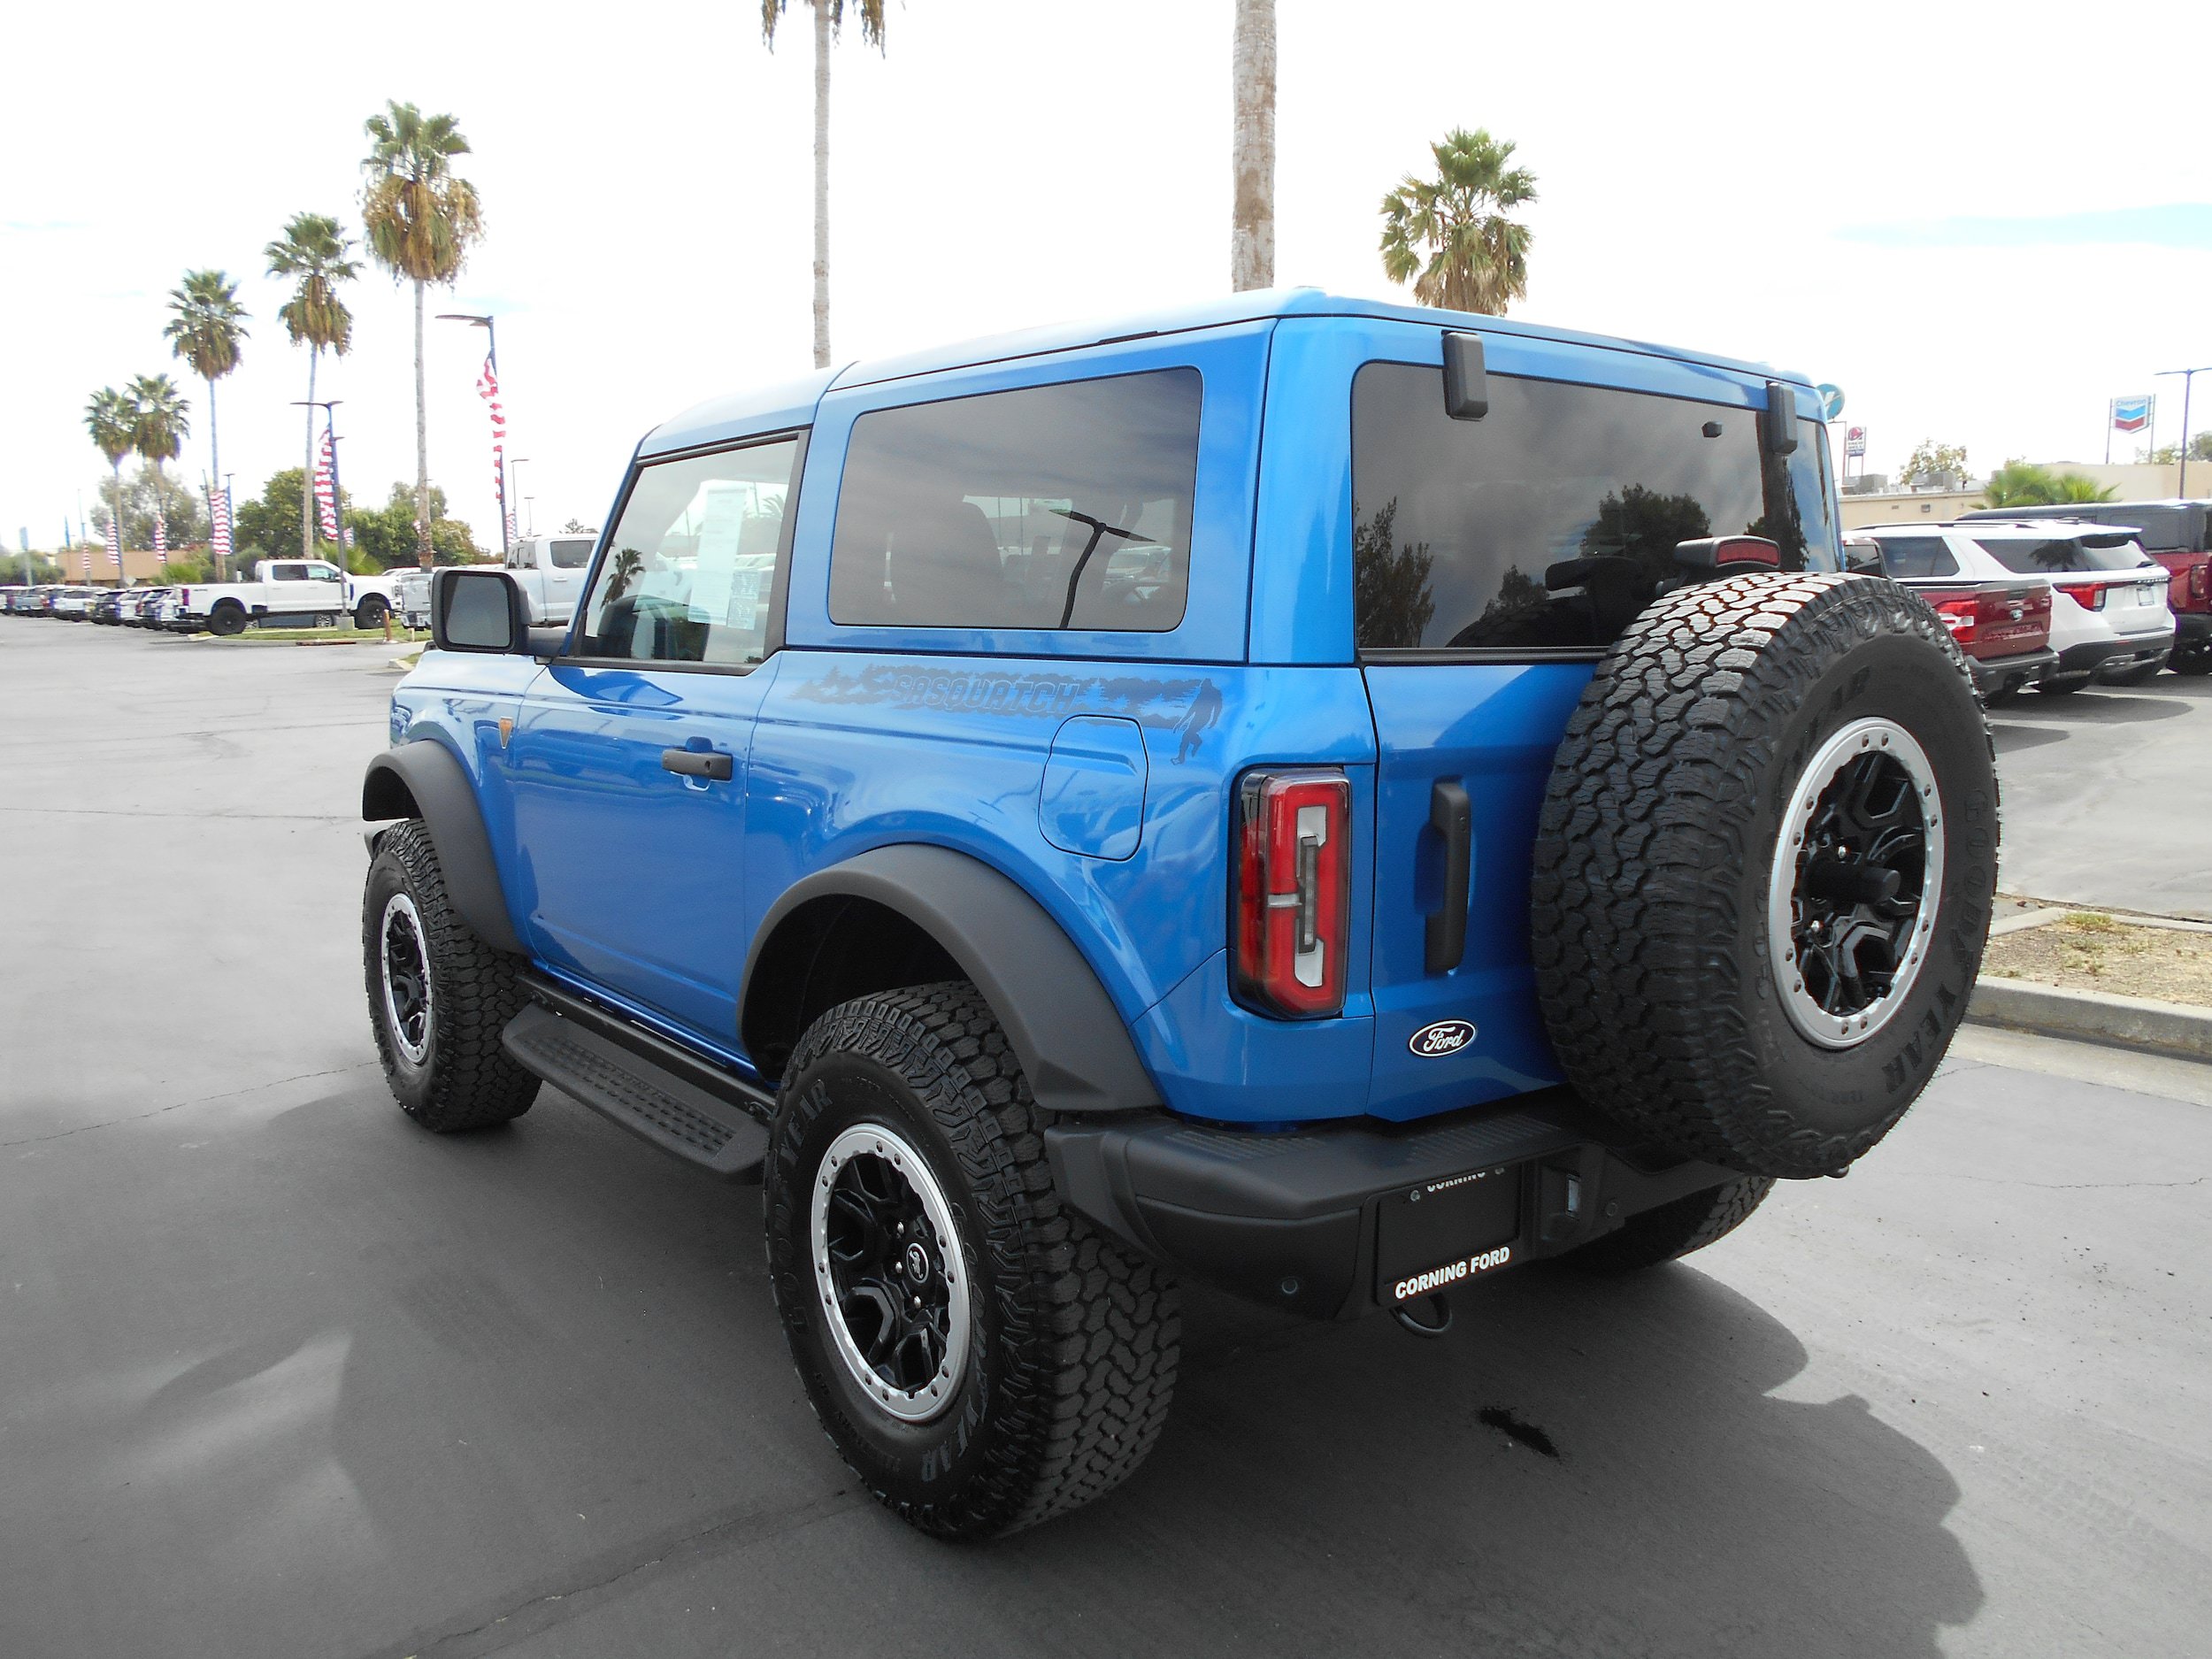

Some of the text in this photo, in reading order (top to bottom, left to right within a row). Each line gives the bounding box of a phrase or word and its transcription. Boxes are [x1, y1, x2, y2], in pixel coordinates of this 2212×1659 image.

[894, 674, 1080, 713] SASQUATCH
[1423, 1025, 1465, 1052] Ford
[1394, 1246, 1511, 1300] CORNING FORD
